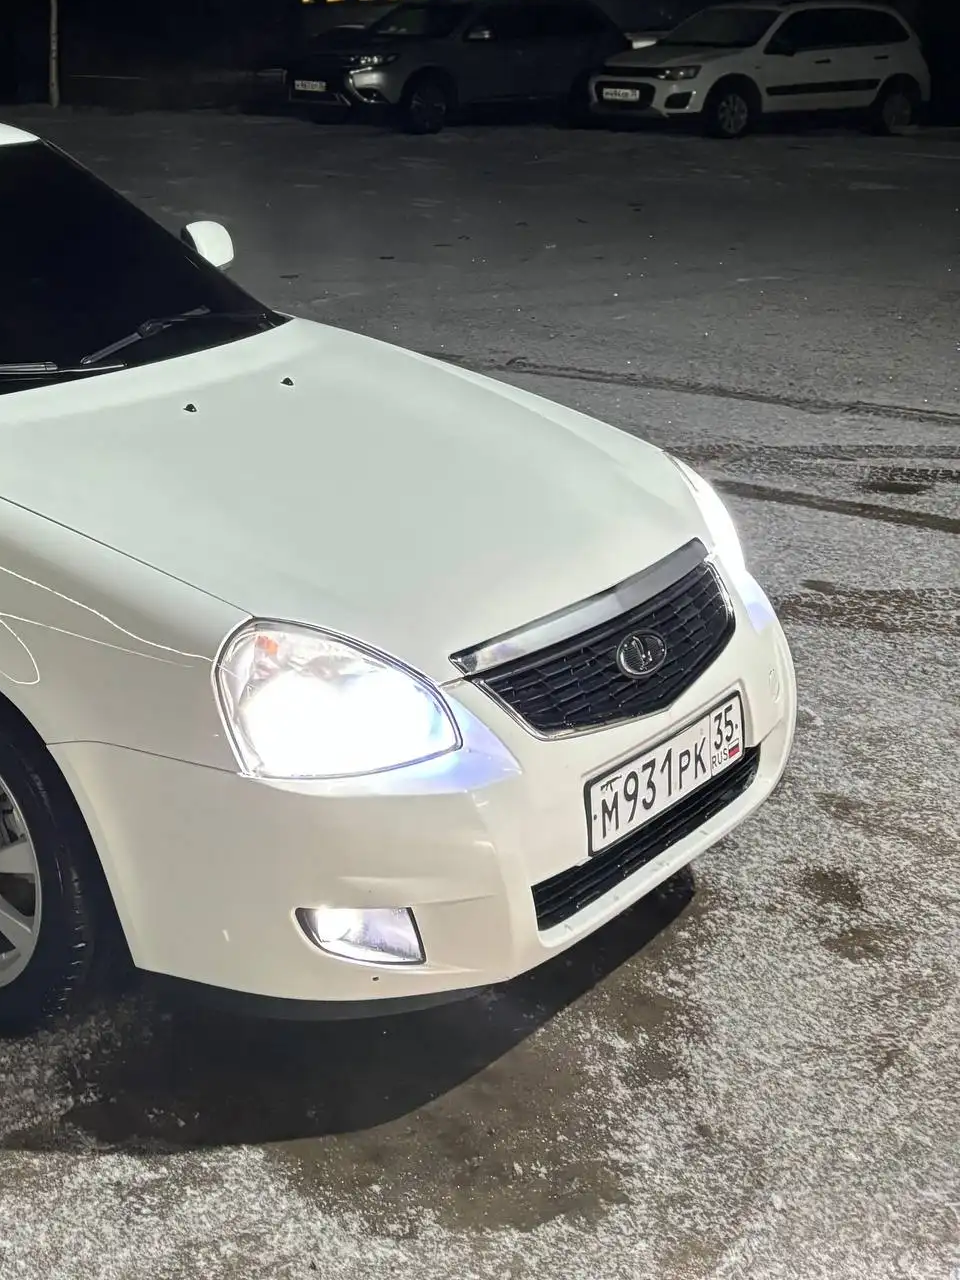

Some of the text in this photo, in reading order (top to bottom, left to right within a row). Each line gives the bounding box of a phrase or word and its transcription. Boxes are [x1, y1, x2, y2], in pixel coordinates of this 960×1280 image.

[601, 704, 734, 839] М931РК 35
[711, 749, 728, 769] RUS
